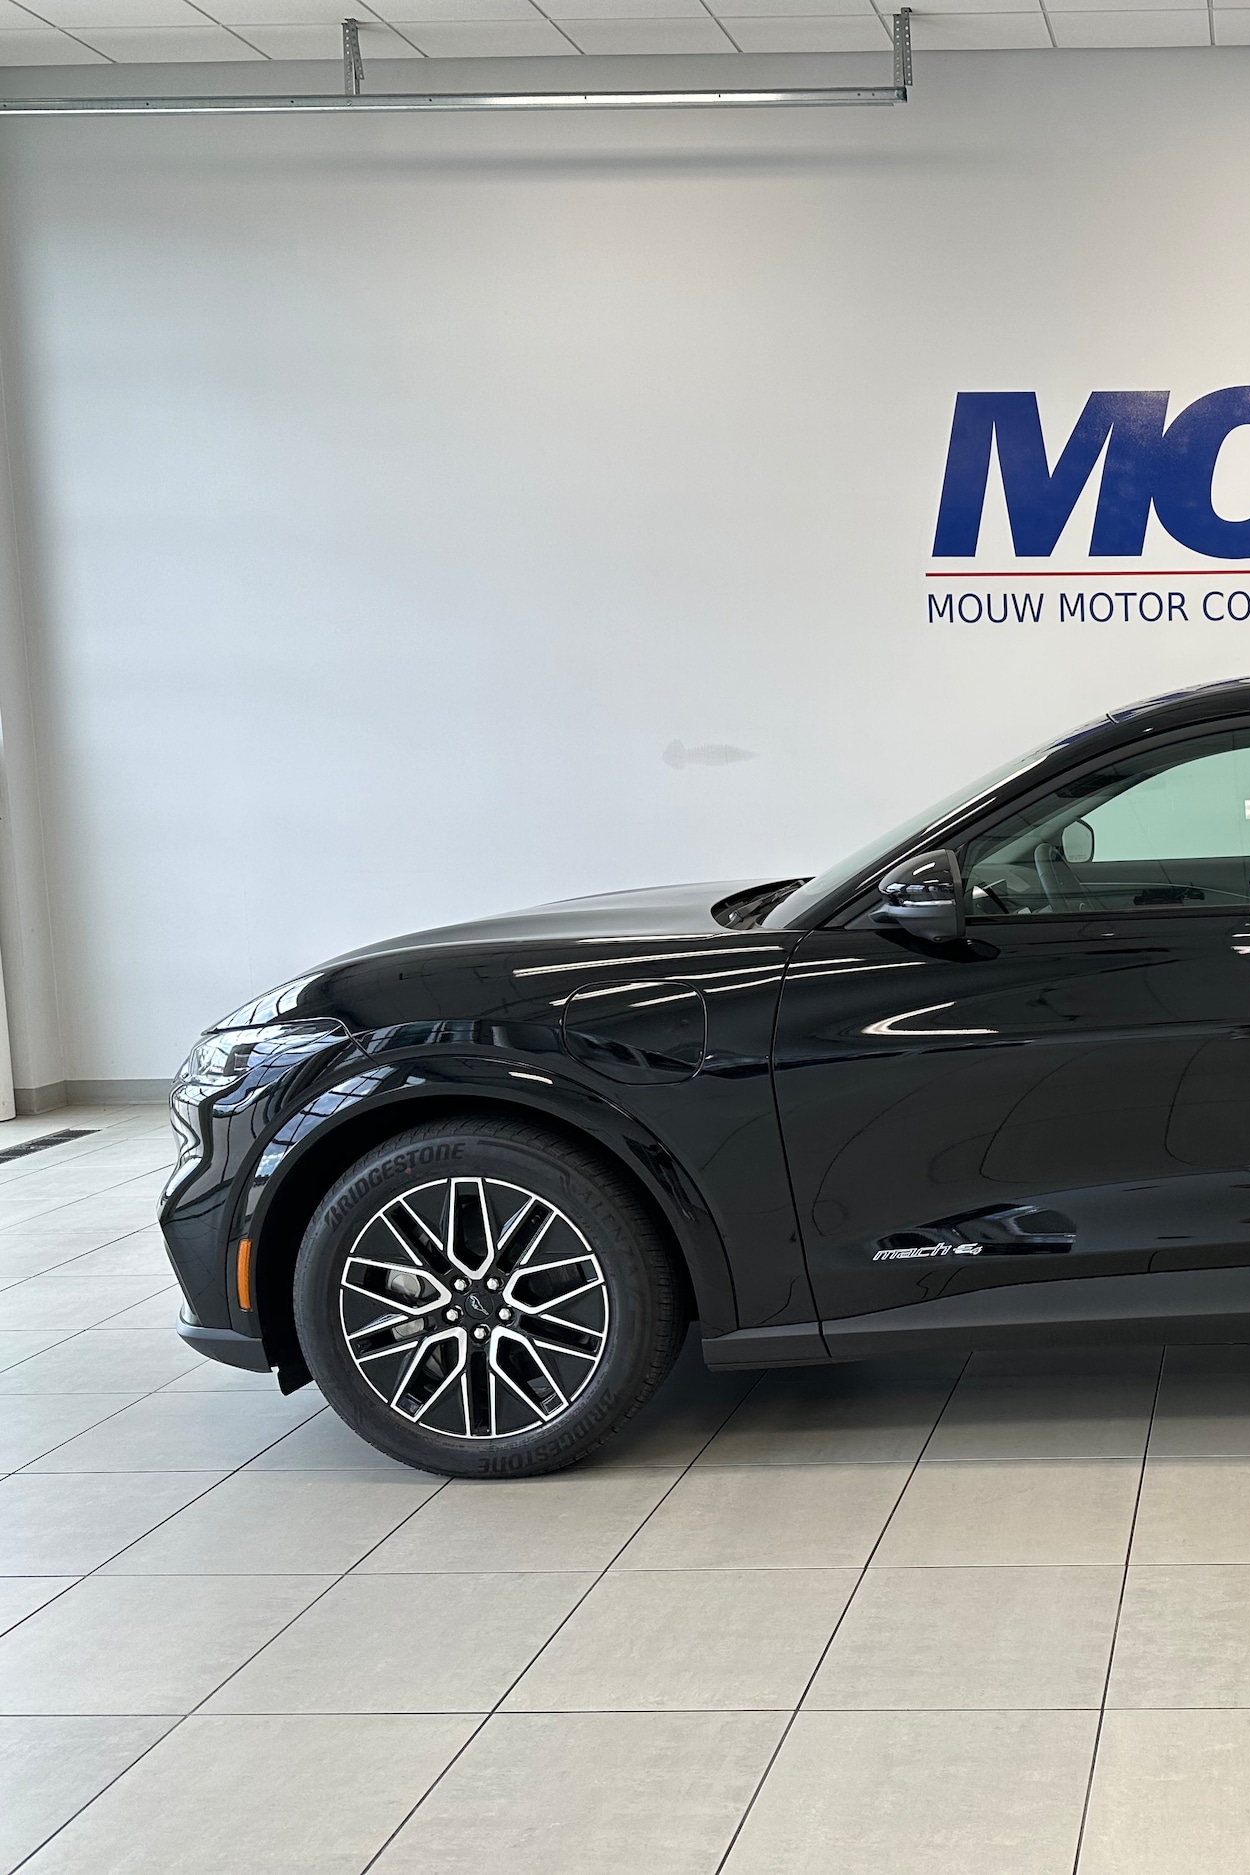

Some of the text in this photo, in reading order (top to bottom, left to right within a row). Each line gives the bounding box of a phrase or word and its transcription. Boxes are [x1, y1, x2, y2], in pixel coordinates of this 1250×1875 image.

[927, 592, 1044, 623] MOUW
[1059, 591, 1188, 622] MOTOR
[1202, 590, 1250, 621] CO
[323, 1142, 466, 1233] BRIDGESTONE
[477, 1387, 621, 1475] BRIDGESTONE
